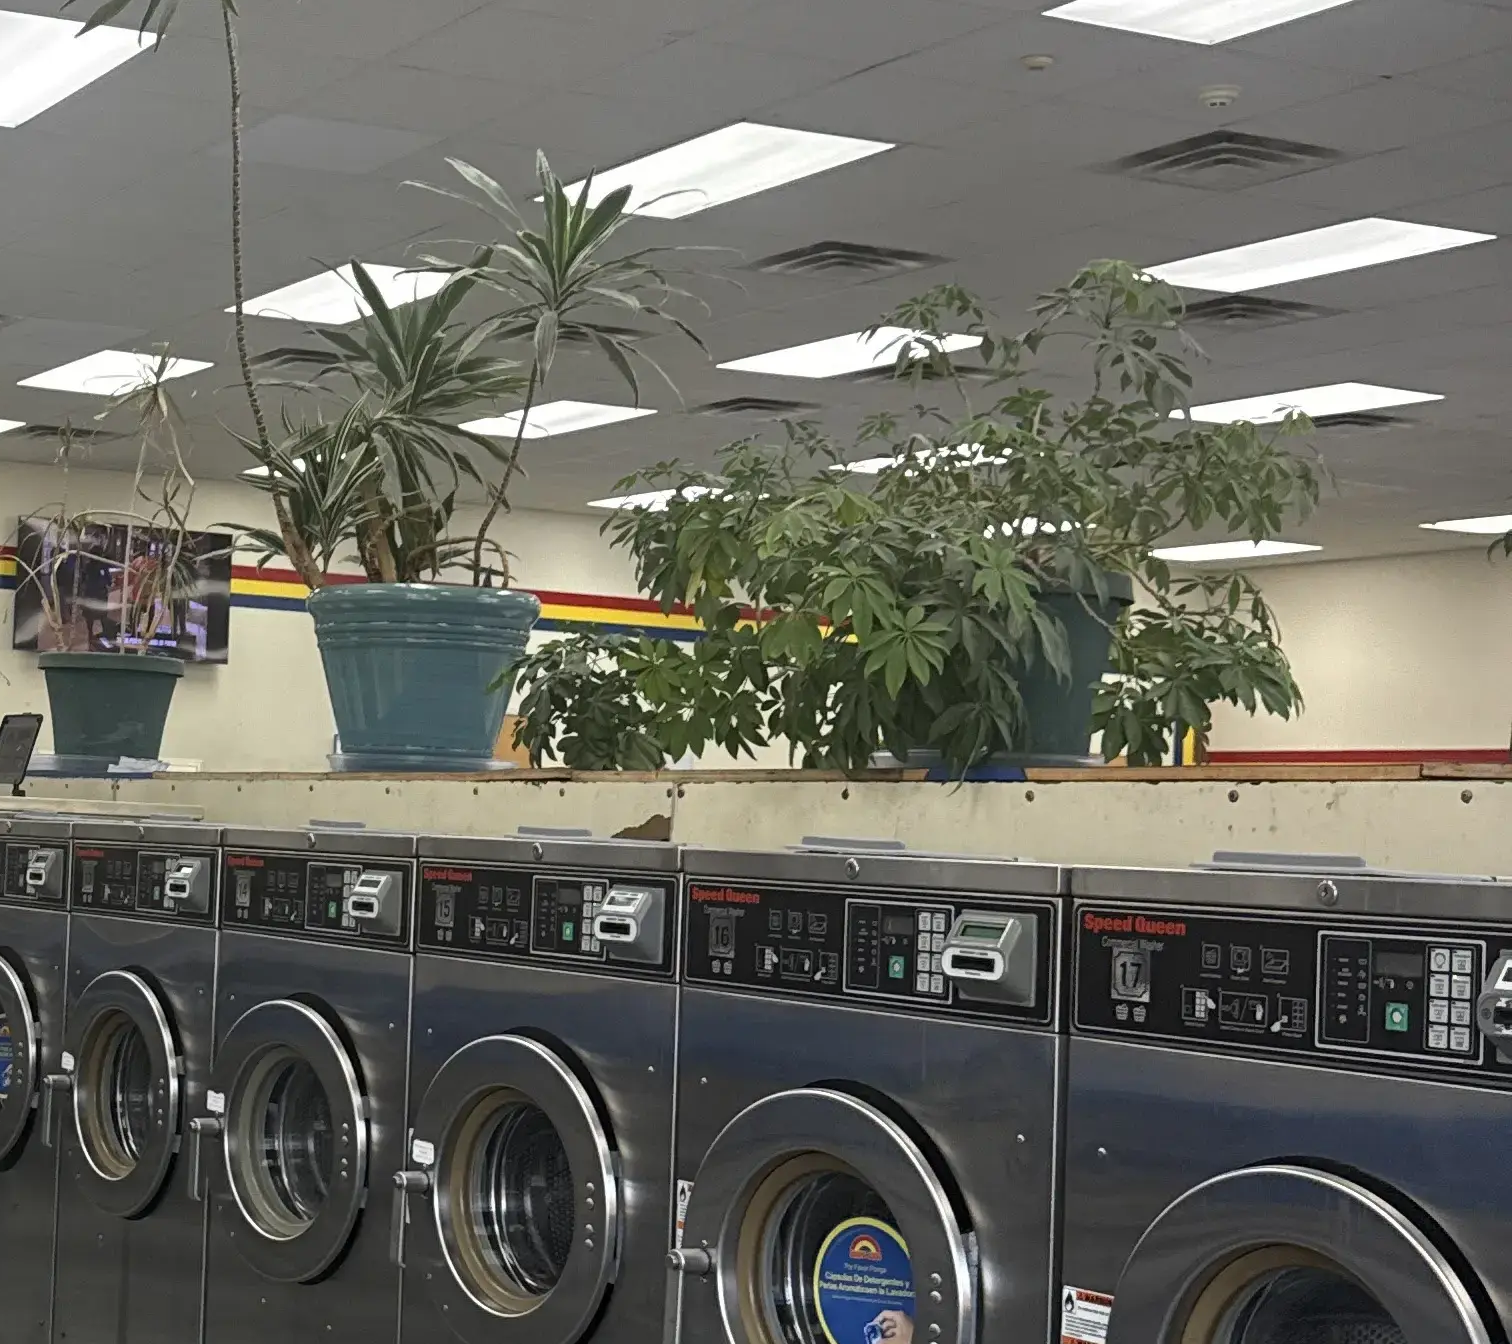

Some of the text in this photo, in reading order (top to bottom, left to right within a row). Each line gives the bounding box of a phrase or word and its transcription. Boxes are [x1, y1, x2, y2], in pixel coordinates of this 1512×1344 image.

[691, 886, 760, 904] Speed Queen
[439, 899, 451, 918] 15
[714, 924, 730, 947] 16
[1083, 912, 1186, 936] Speed Queen
[1119, 961, 1143, 989] 17
